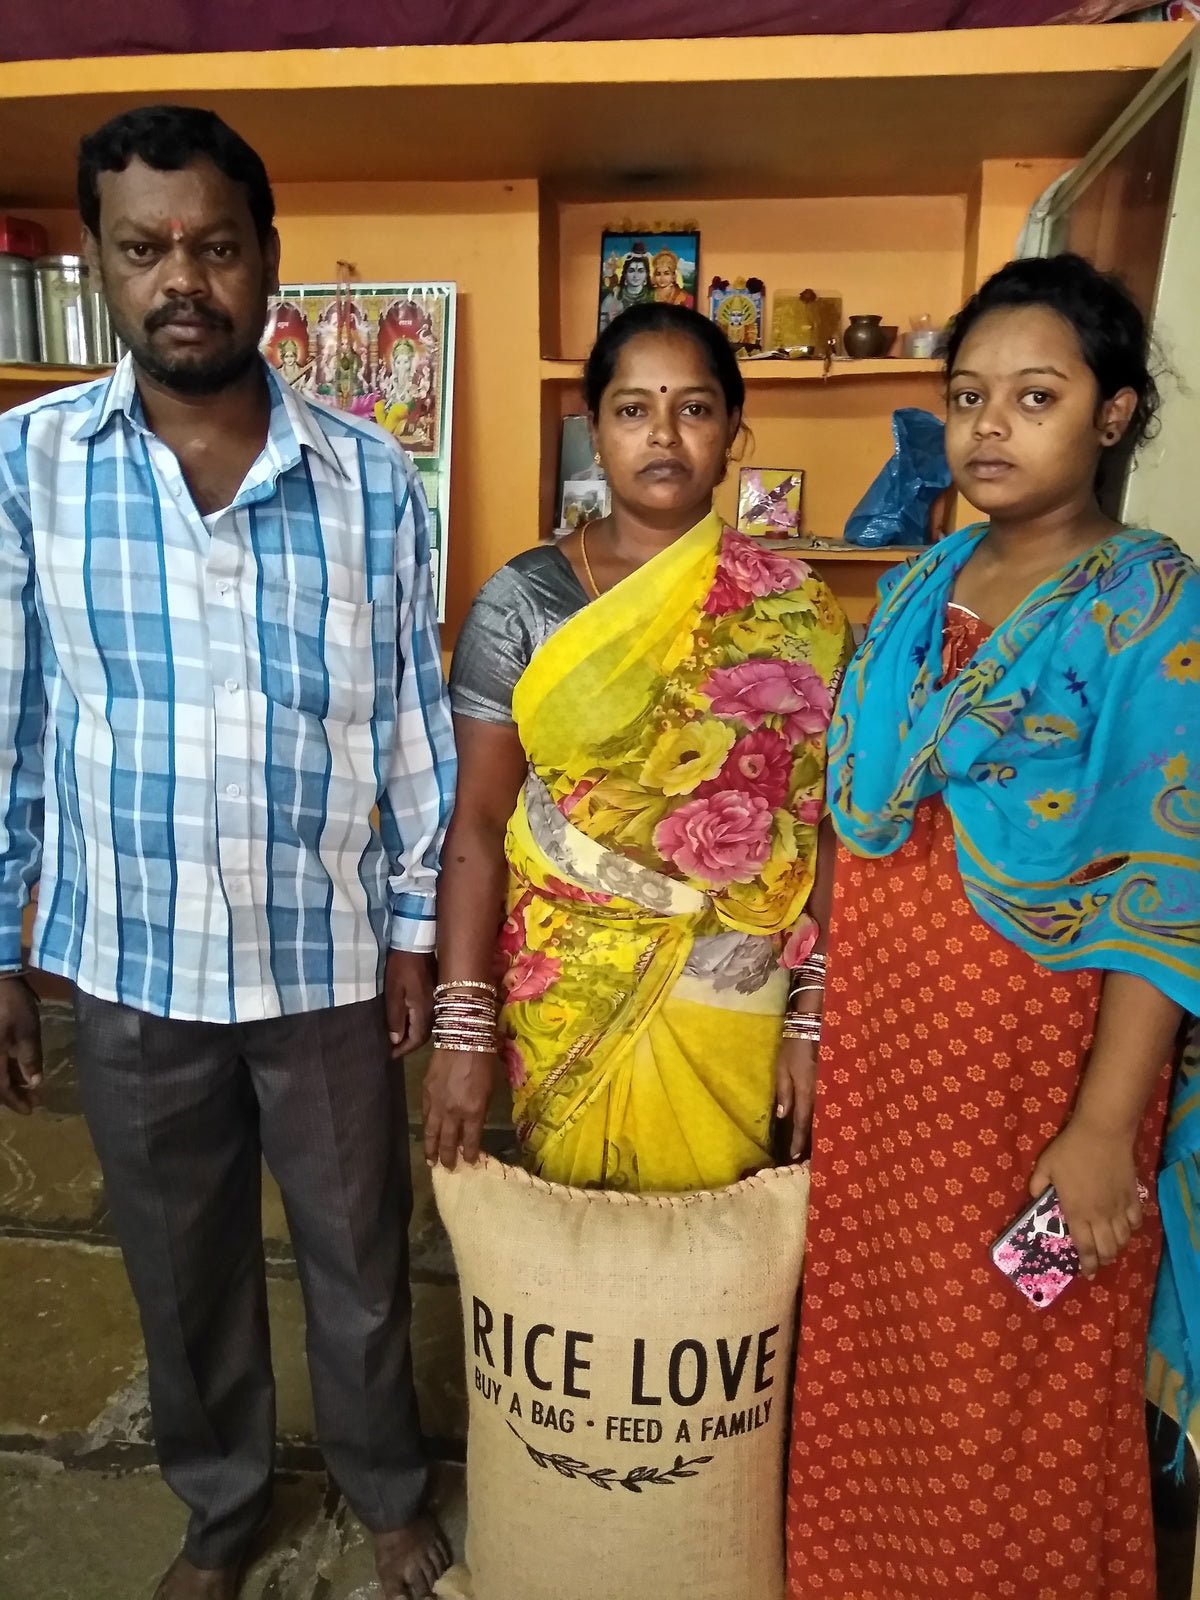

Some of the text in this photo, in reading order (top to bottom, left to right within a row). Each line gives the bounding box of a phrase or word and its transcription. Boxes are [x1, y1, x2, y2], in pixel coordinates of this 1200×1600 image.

[472, 1295, 780, 1407] RICE LOVE
[475, 1365, 773, 1443] BUY A BAG FEED A FAMILY
